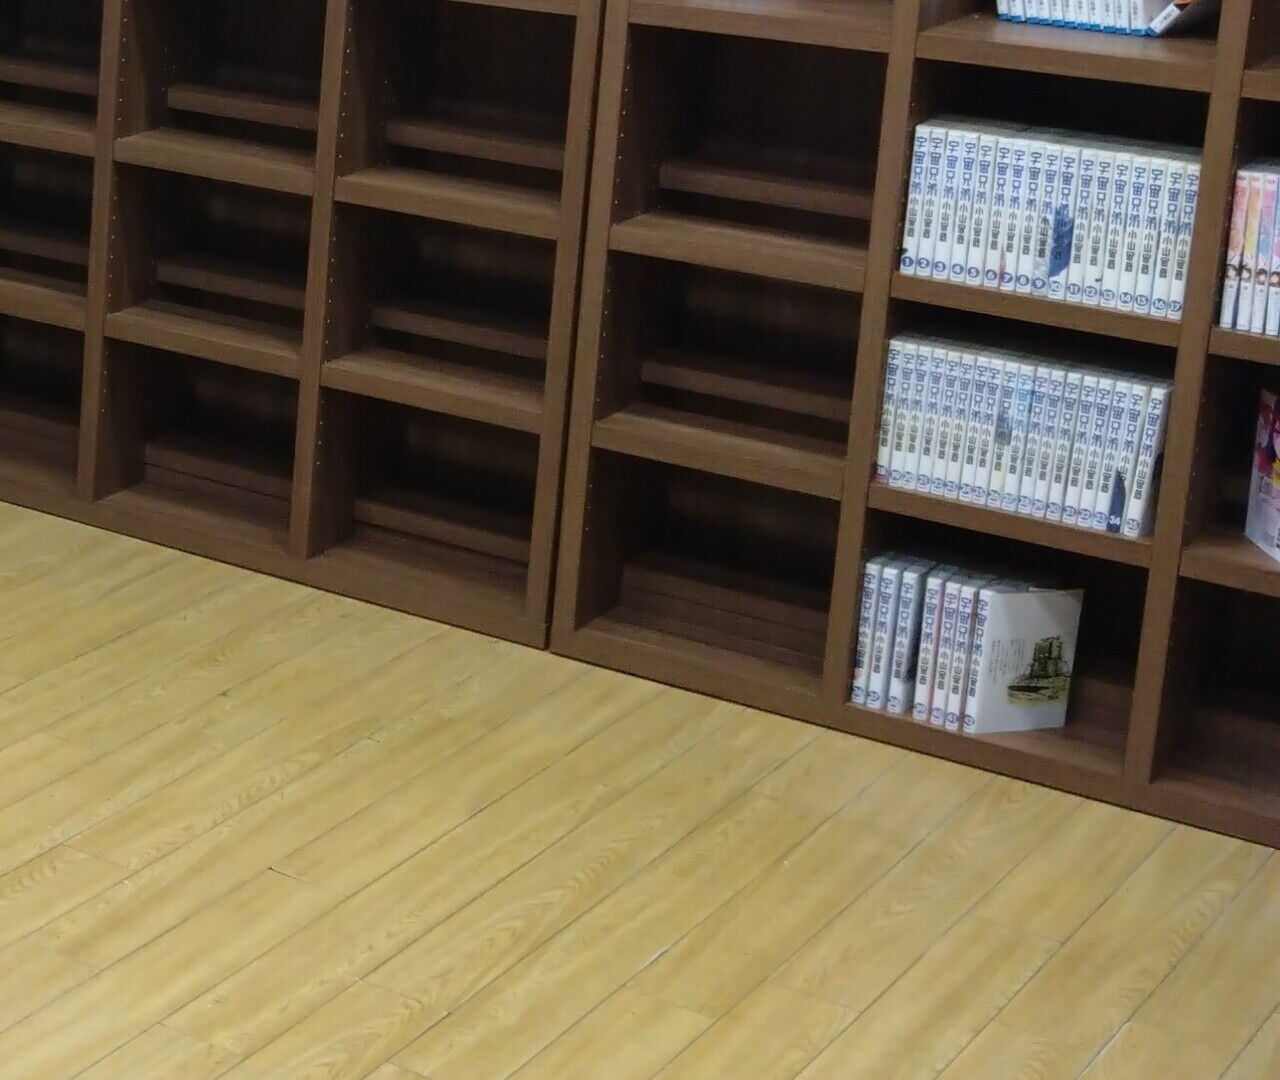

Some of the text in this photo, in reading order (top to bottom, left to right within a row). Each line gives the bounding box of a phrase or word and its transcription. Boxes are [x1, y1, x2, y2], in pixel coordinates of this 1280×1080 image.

[927, 137, 943, 196] 宇宙兄弟
[943, 141, 959, 200] 宇宙兄弟
[976, 145, 992, 205] 宇宙兄弟
[995, 147, 1010, 207] 宇宙兄弟
[1025, 151, 1042, 212] 宇宙兄弟
[1042, 154, 1058, 215] 宇宙兄弟
[1093, 161, 1110, 222] 宇宙兄弟
[1111, 164, 1128, 225] 宇宙兄弟
[1128, 166, 1145, 228] 宇宙兄弟
[1164, 172, 1182, 235] 宇宙兄弟
[1075, 386, 1094, 445] 宇宙兄弟
[1091, 388, 1110, 448] 宇宙兄弟
[1140, 398, 1162, 457] 宇宙兄弟
